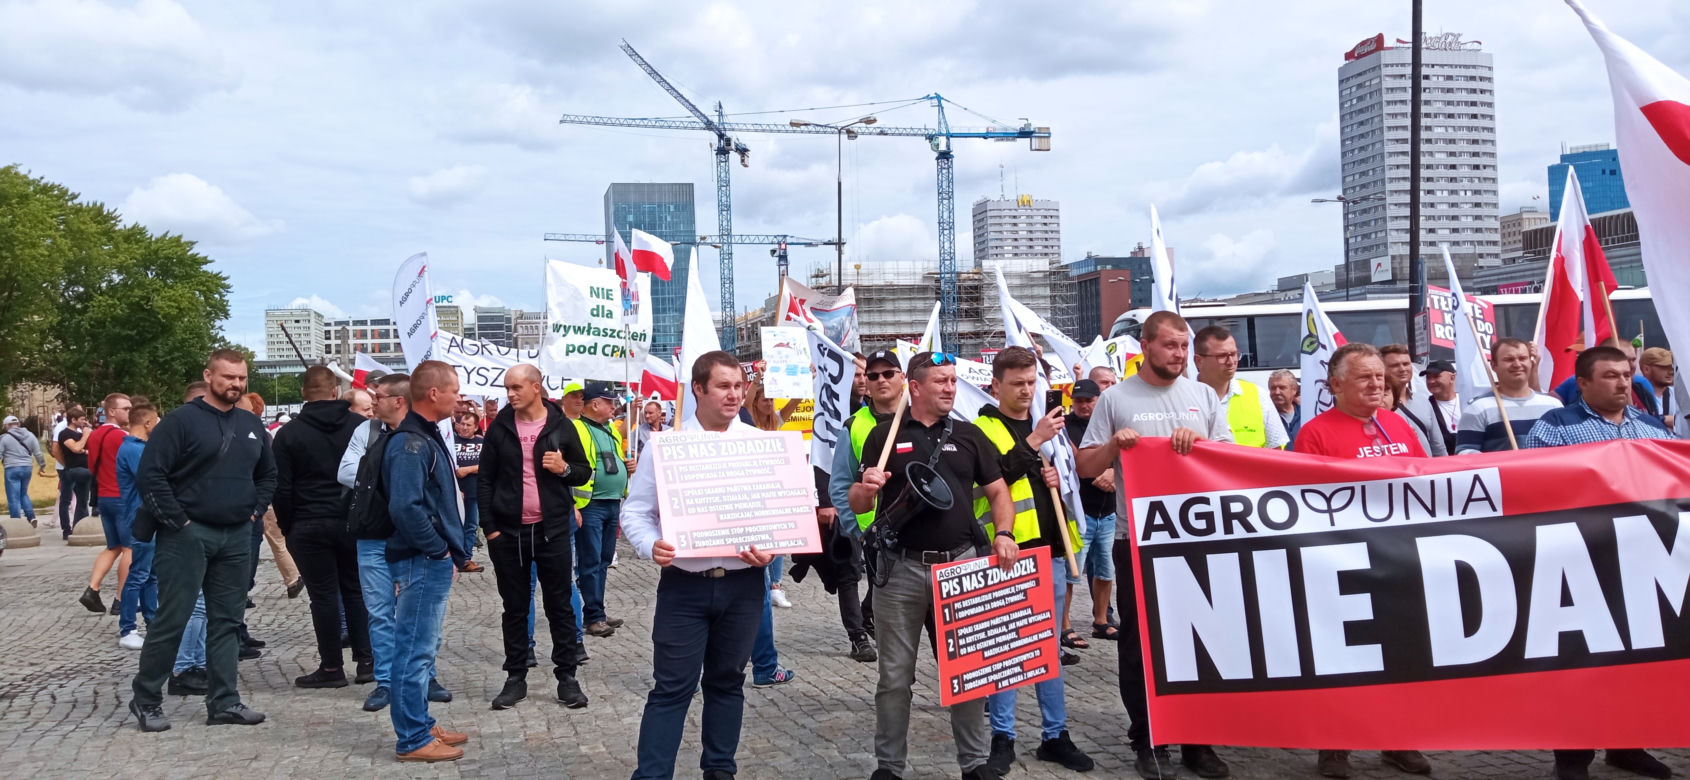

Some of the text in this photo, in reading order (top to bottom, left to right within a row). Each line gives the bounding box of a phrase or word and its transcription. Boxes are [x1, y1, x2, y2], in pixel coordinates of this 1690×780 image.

[434, 295, 453, 304] UPC
[589, 286, 614, 301] NIE
[590, 307, 613, 319] dla
[565, 342, 596, 357] pod
[662, 437, 784, 460] PIS NAS ZDRADZIŁ
[1356, 443, 1409, 458] JESTEM
[666, 469, 672, 481] 1
[672, 497, 679, 508] 2
[1140, 473, 1499, 541] AGROUNIA
[680, 535, 685, 546] 3
[938, 559, 988, 580] AGROUNIA
[941, 577, 960, 598] PIS
[961, 570, 984, 593] NAS
[944, 607, 949, 621] 1
[1152, 542, 1385, 683] NIE
[948, 638, 953, 652] 2
[952, 678, 958, 693] 3
